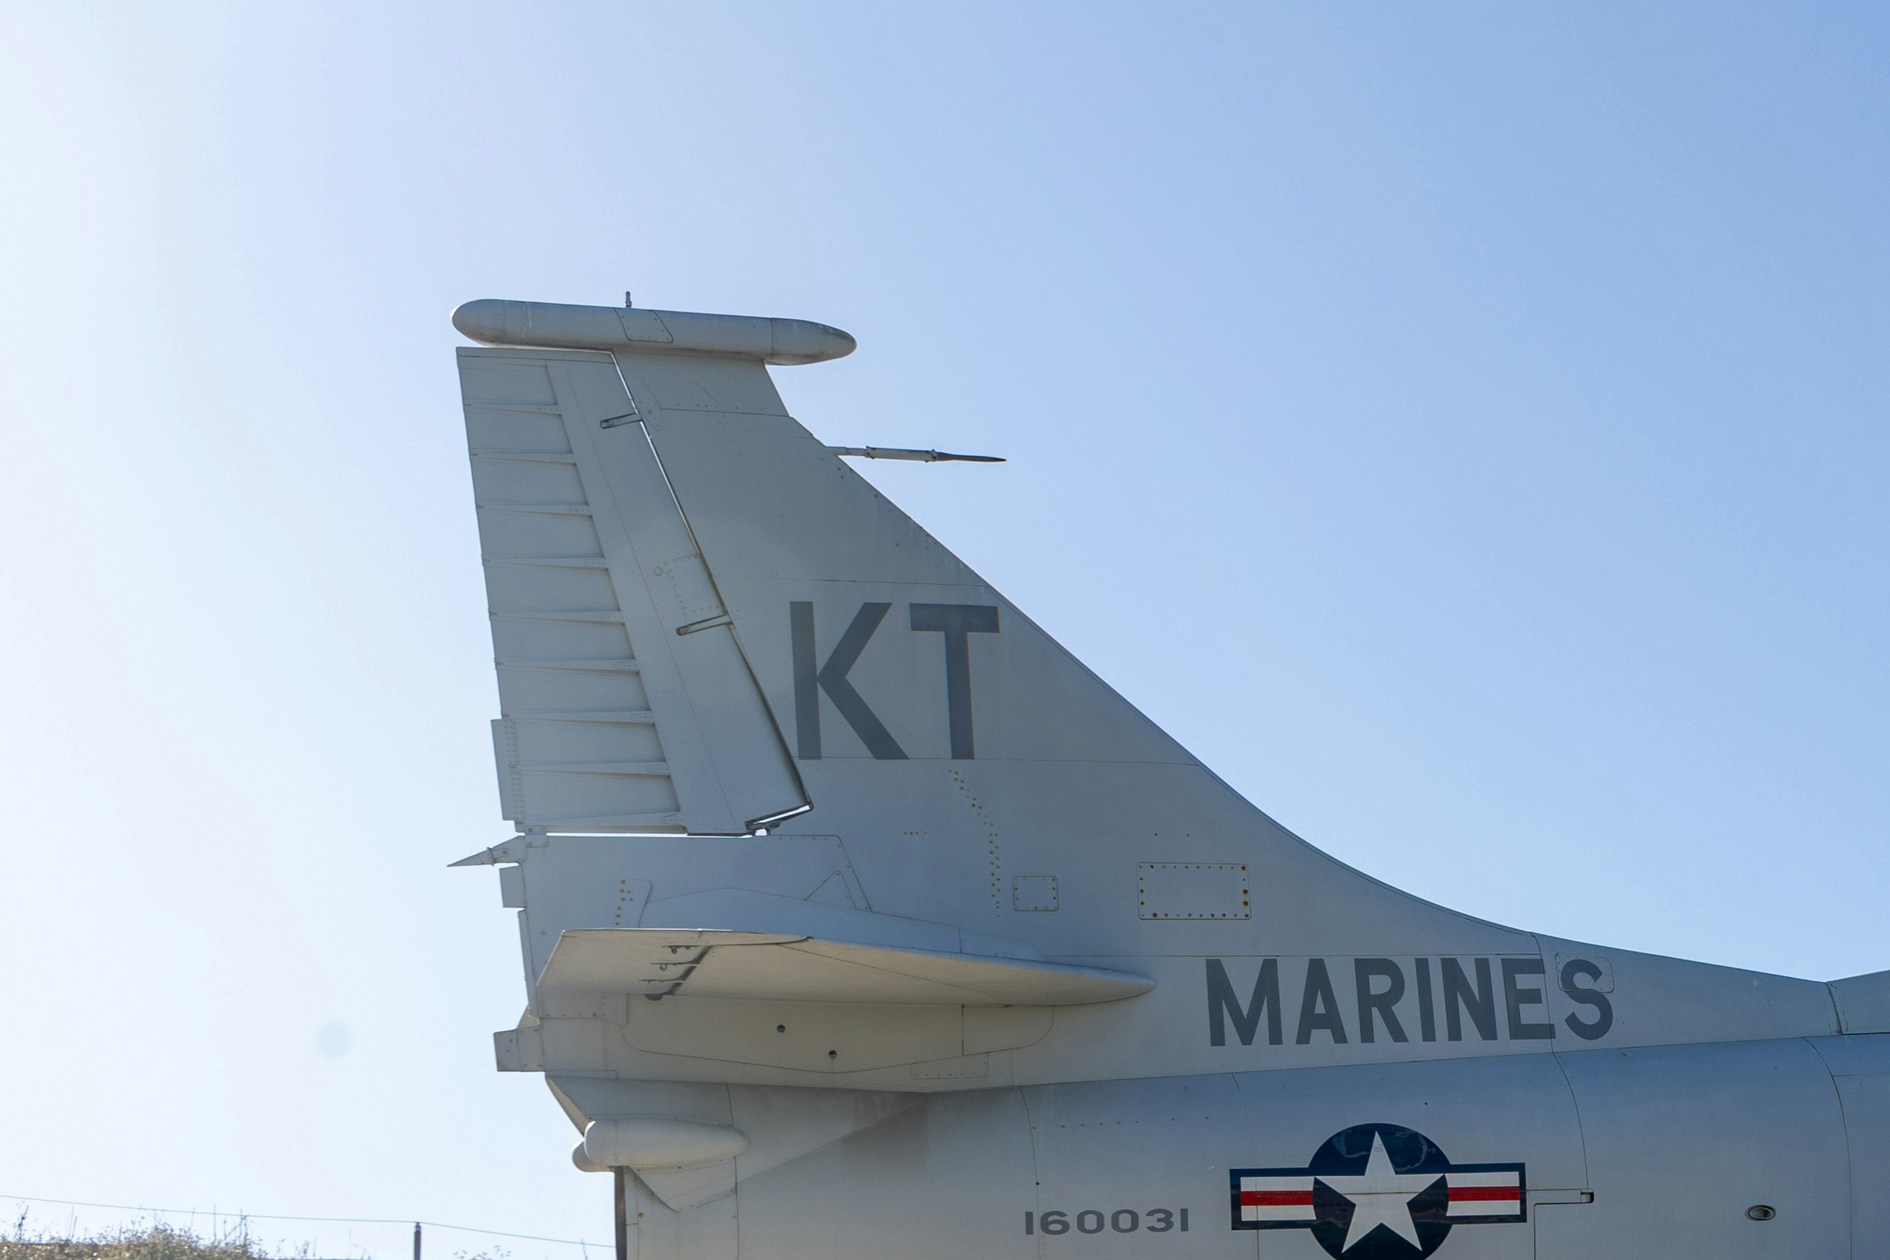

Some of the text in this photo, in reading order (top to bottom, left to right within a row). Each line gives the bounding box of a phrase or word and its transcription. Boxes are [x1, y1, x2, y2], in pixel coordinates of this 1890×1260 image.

[790, 601, 1000, 760] KT
[1205, 957, 1614, 1047] MARINES
[1024, 1207, 1190, 1236] 160031
